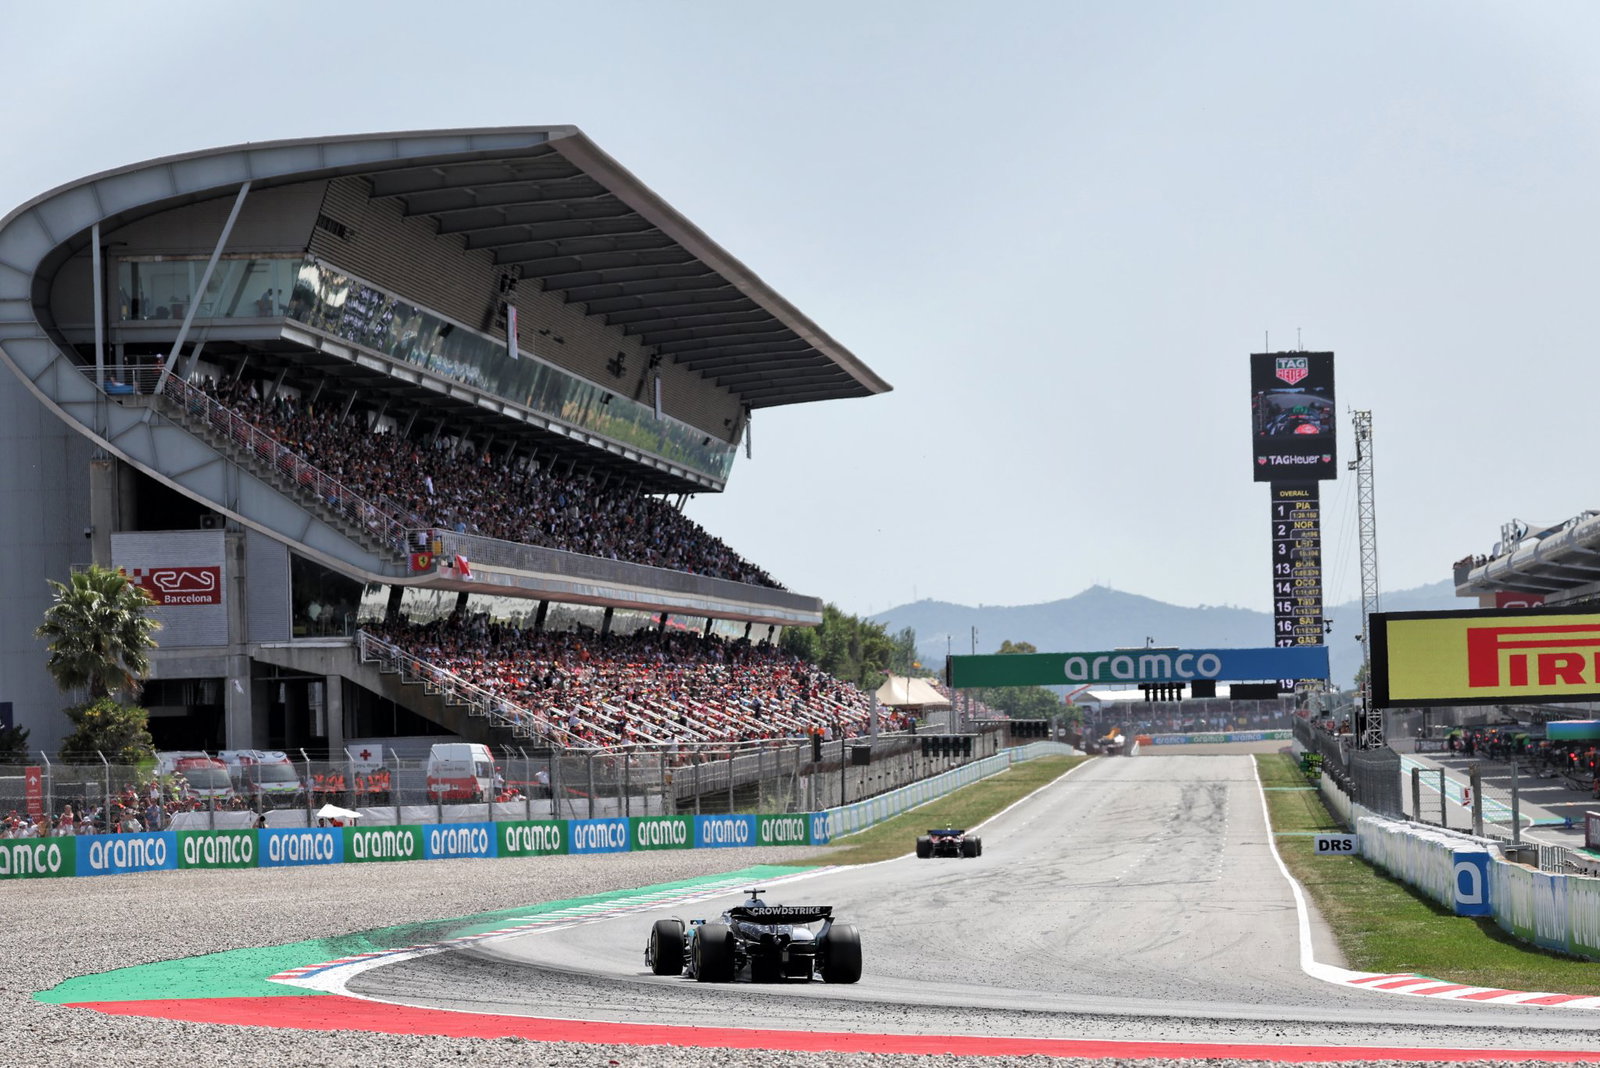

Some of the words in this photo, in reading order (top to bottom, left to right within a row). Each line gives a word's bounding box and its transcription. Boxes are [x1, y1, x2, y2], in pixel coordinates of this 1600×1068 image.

[1279, 359, 1305, 369] TAG
[1278, 505, 1284, 516] 1
[1296, 502, 1311, 510] PIA
[1278, 525, 1286, 536] 2
[1294, 521, 1314, 529] NOR
[1278, 543, 1286, 555] 3
[1276, 563, 1291, 575] 13
[1276, 582, 1291, 594] 14
[164, 593, 212, 604] Barcelona
[1277, 601, 1292, 613] 15
[1278, 620, 1292, 632] 16
[1299, 617, 1314, 625] SAI
[1278, 639, 1293, 648] 17
[1297, 636, 1317, 644] GAS
[1467, 623, 1600, 688] PIR
[1064, 653, 1222, 680] aramco
[1279, 679, 1294, 689] 19
[574, 822, 625, 849] aramco
[638, 820, 687, 846] aramco
[703, 819, 748, 843] aramco
[762, 818, 804, 842] aramco
[353, 830, 414, 858] aramco
[431, 828, 489, 855] aramco
[505, 825, 560, 851] aramco
[1319, 839, 1352, 852] DRS
[89, 837, 166, 870] aramco
[184, 834, 253, 865] aramco
[269, 832, 333, 862] aramco
[752, 906, 821, 916] CROWDSTRIKE
